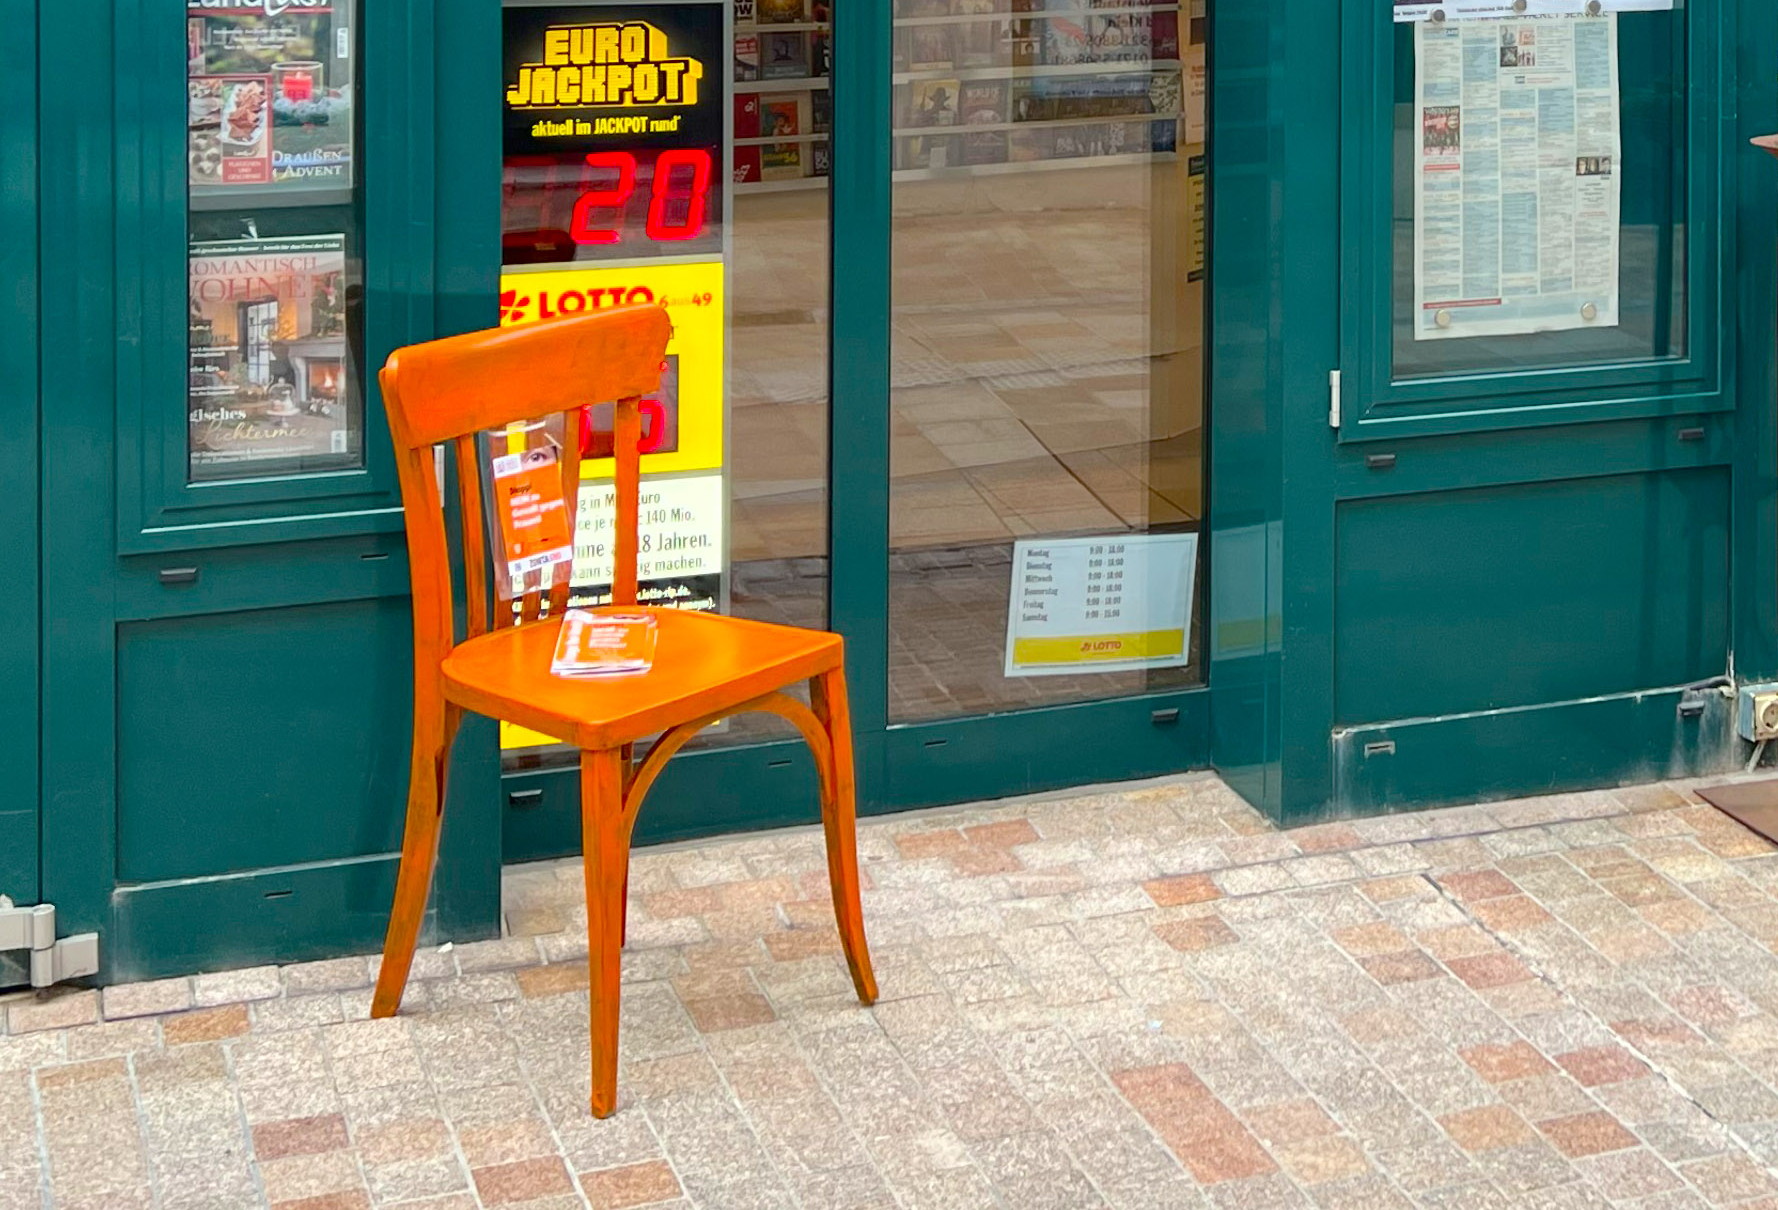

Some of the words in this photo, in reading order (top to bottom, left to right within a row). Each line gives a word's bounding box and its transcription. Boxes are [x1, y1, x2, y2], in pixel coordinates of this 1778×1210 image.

[543, 23, 655, 66] EURO
[506, 61, 693, 107] JACKPOT
[531, 120, 573, 137] aktuell
[576, 119, 591, 134] im
[594, 117, 648, 134] JACKPOT
[570, 150, 711, 244] 20
[539, 286, 654, 320] LOTTO
[638, 493, 661, 504] uro
[647, 509, 666, 524] 140
[671, 508, 695, 522] Mio.
[657, 532, 712, 552] Jahren.
[655, 555, 706, 572] machen.
[1093, 641, 1121, 651] LOTTO
